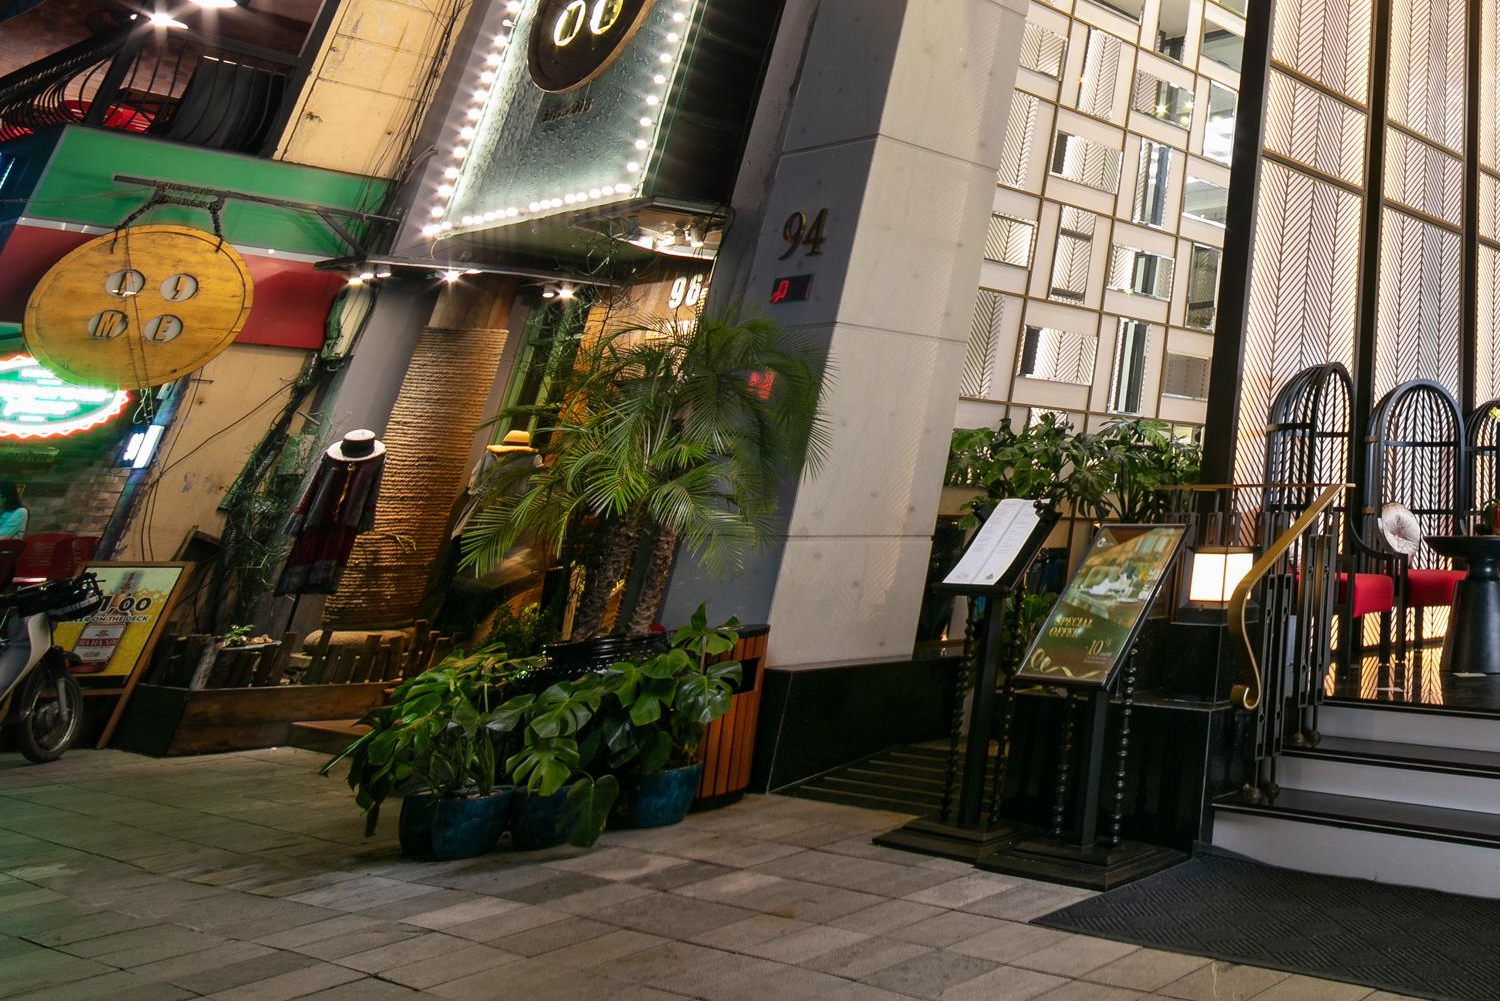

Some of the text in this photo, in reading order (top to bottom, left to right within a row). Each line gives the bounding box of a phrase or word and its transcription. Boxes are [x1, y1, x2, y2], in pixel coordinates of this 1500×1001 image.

[777, 207, 829, 260] 94
[1055, 614, 1094, 629] SPECIAL
[1048, 627, 1083, 638] OFFER
